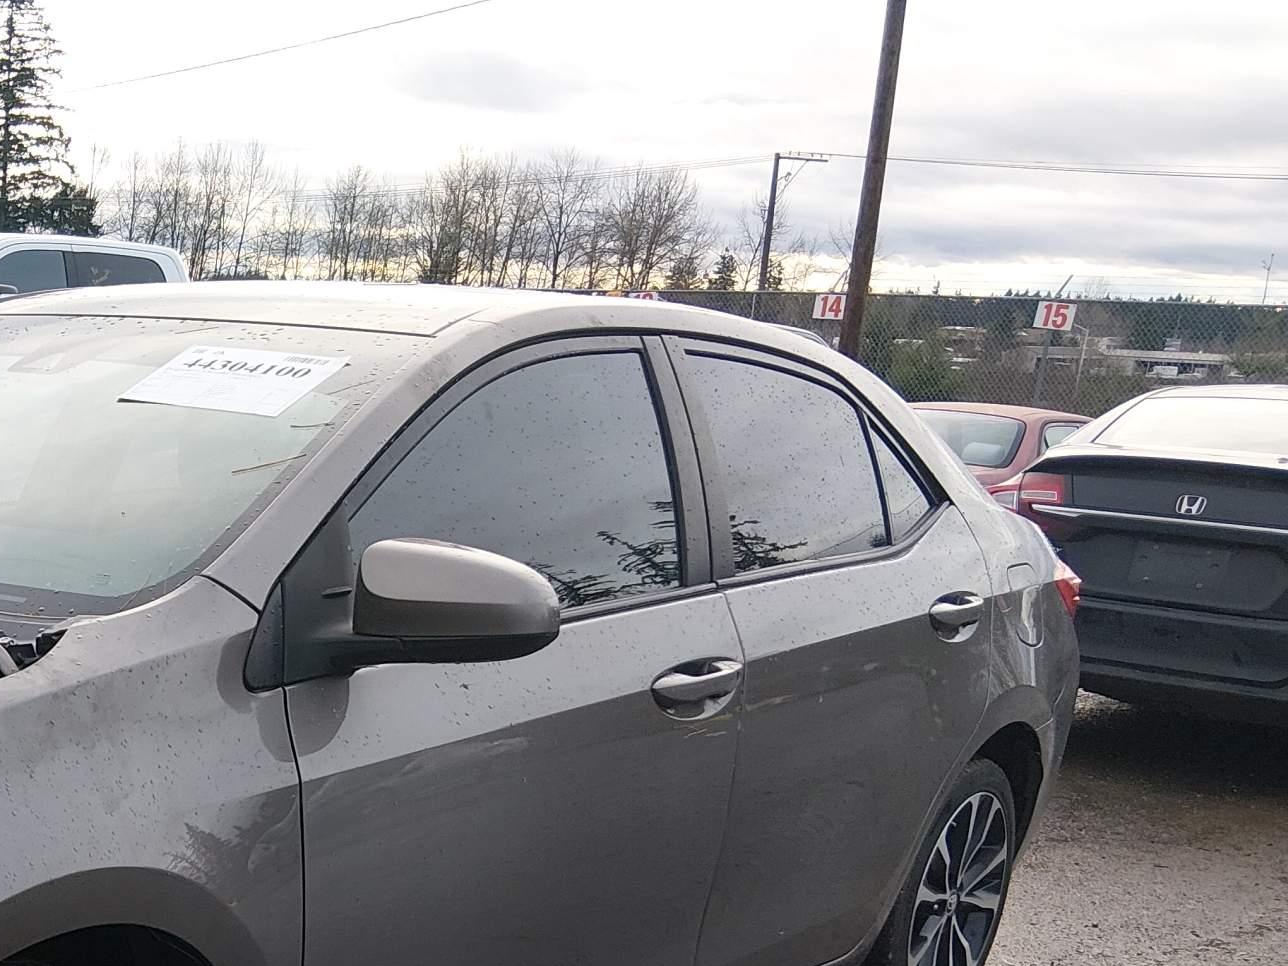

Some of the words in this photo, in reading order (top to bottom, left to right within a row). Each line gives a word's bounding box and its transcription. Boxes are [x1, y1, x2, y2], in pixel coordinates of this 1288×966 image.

[820, 295, 842, 318] 14
[1042, 303, 1070, 329] 15
[184, 358, 312, 378] 44304100
